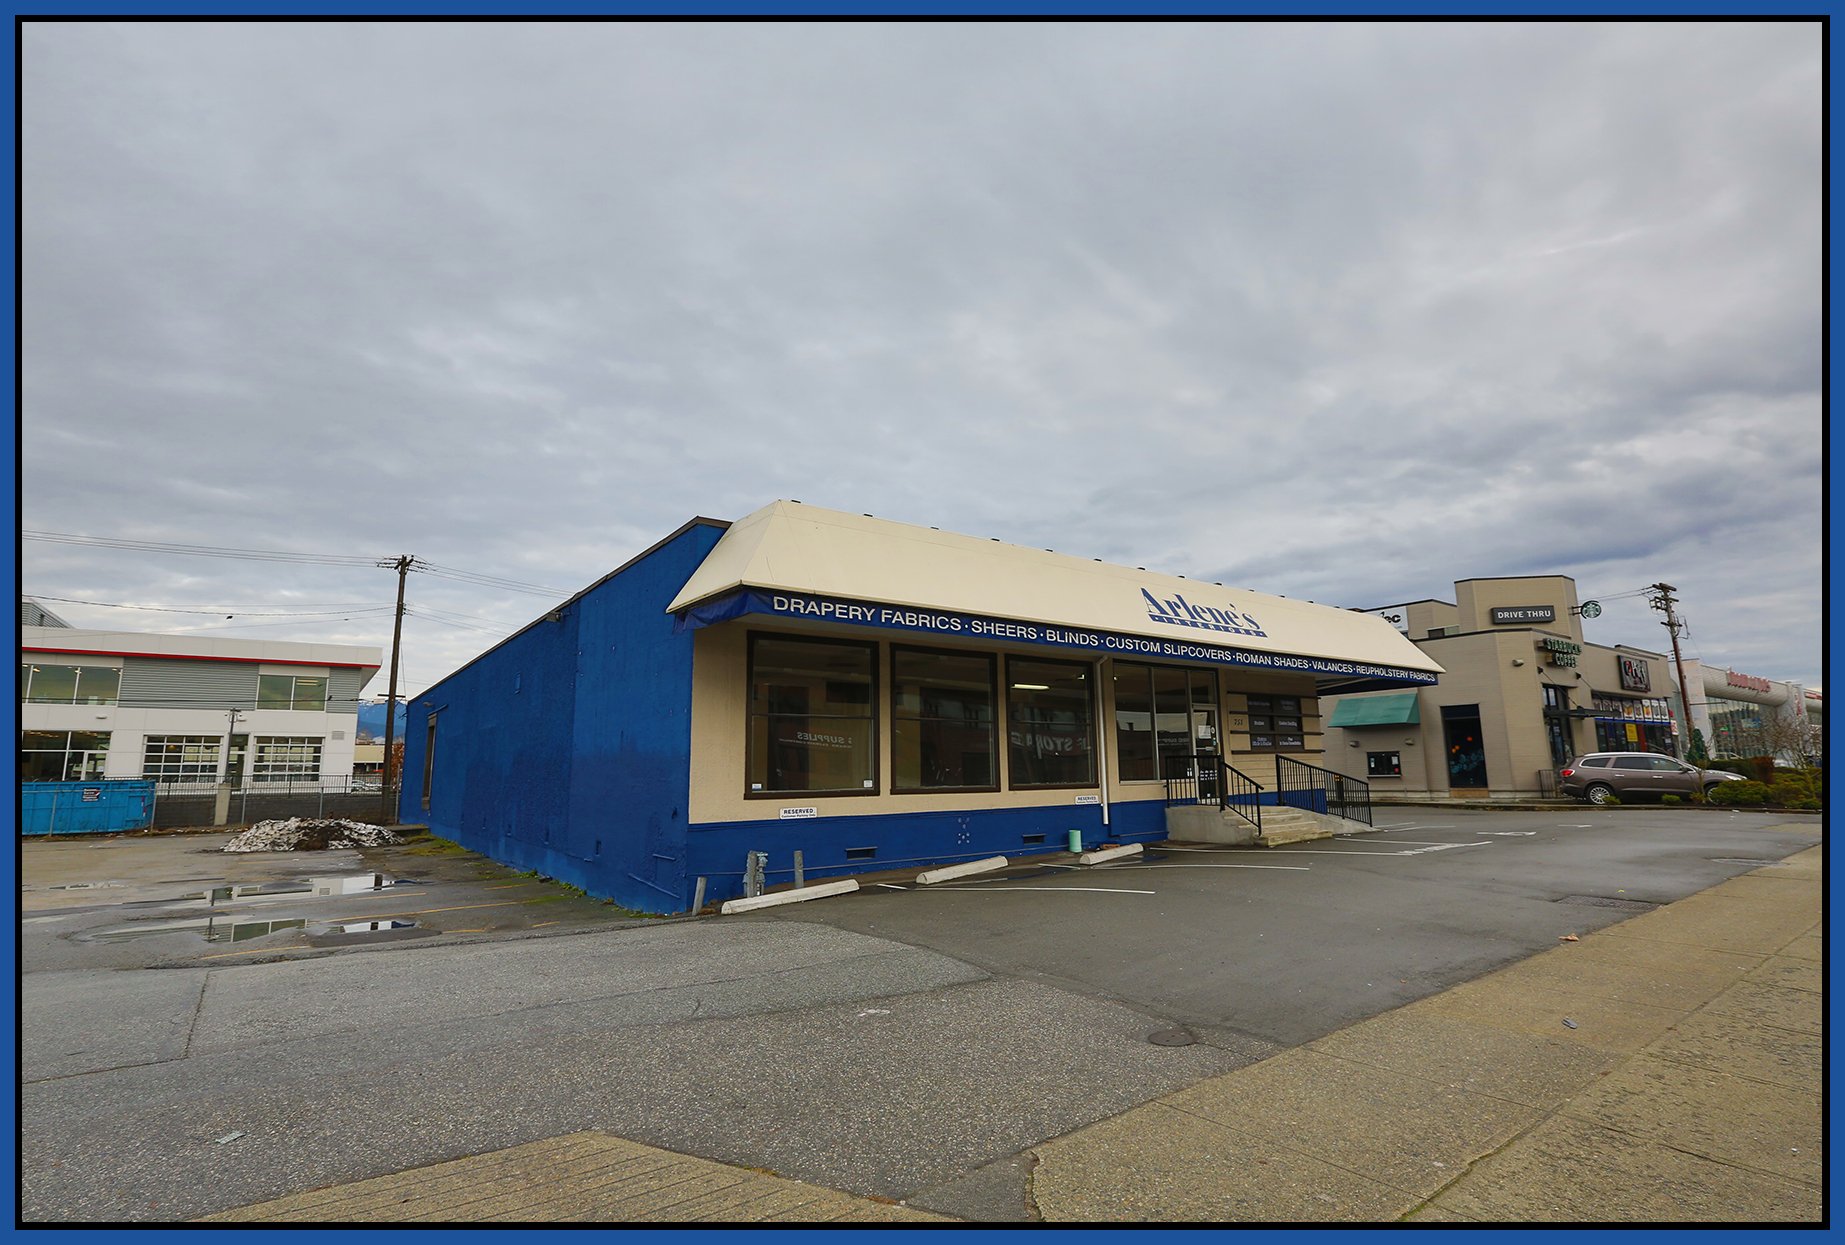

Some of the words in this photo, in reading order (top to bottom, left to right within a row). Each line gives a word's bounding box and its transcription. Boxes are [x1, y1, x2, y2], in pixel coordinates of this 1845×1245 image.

[1141, 587, 1261, 630] Arlene's
[1497, 610, 1524, 619] DRIVE
[1526, 610, 1551, 618] THRU
[773, 596, 876, 621] DRAPERY
[881, 609, 962, 631] FABRICS
[971, 620, 1038, 640] SHEERS
[1046, 629, 1099, 647] BLINDS
[1105, 636, 1161, 653] CUSTOM
[1163, 643, 1232, 661] SLIPCOVERS
[1235, 652, 1272, 665] ROMAN
[1273, 656, 1309, 669] SHADES
[1312, 660, 1353, 673] VALANCES
[1356, 665, 1409, 679] REUPHOLSTERY
[1409, 671, 1436, 682] FABRICS
[1163, 618, 1257, 637] INTERIORS
